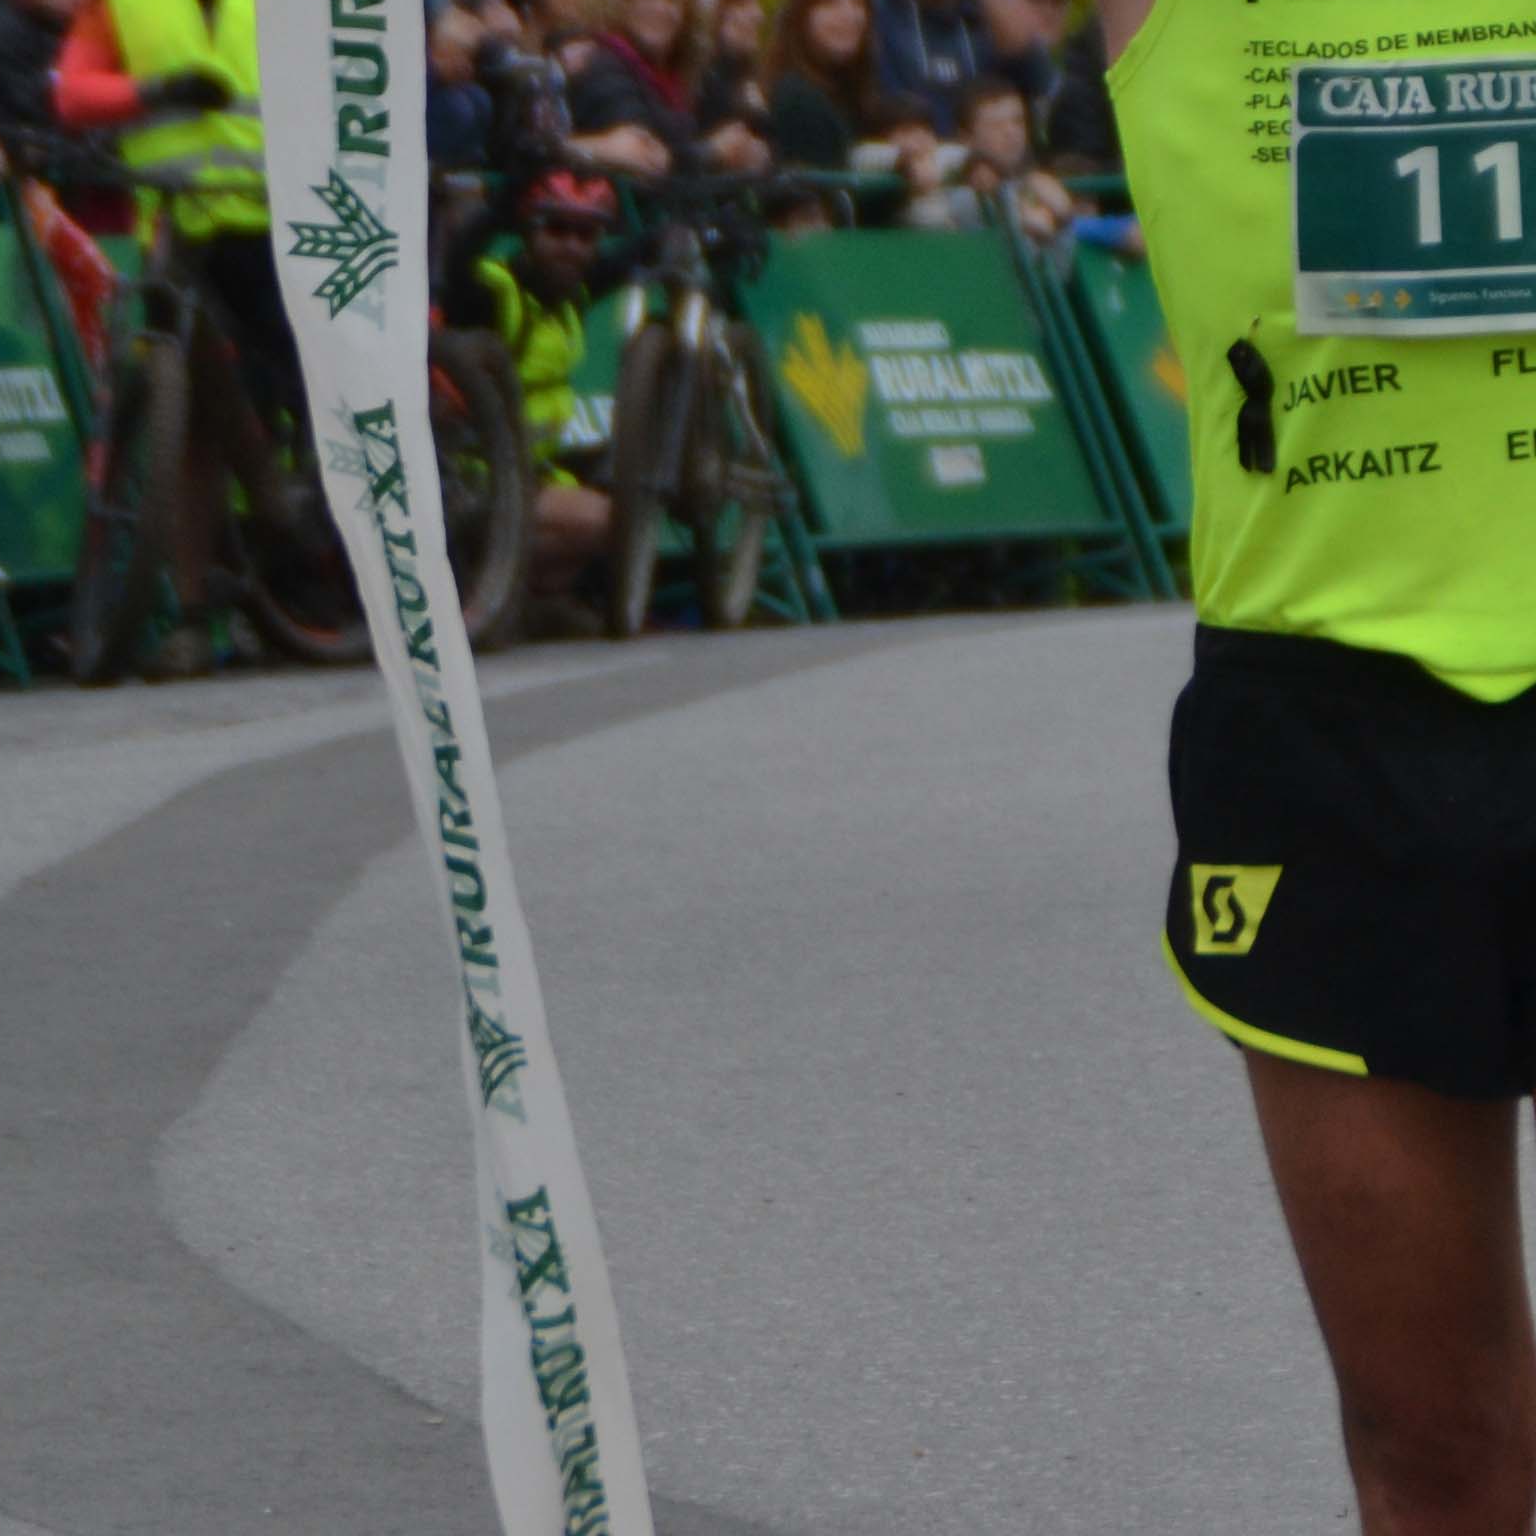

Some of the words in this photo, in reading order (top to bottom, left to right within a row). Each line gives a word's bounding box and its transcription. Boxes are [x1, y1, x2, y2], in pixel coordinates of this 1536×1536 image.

[1244, 39, 1369, 60] -TECLADOS
[1376, 33, 1408, 52] DE
[1320, 72, 1436, 118] CAJA
[1393, 140, 1525, 248] 11
[1281, 363, 1402, 412] JAVIER
[1282, 443, 1443, 495] ARKAITZ
[421, 686, 500, 969] RURAL
